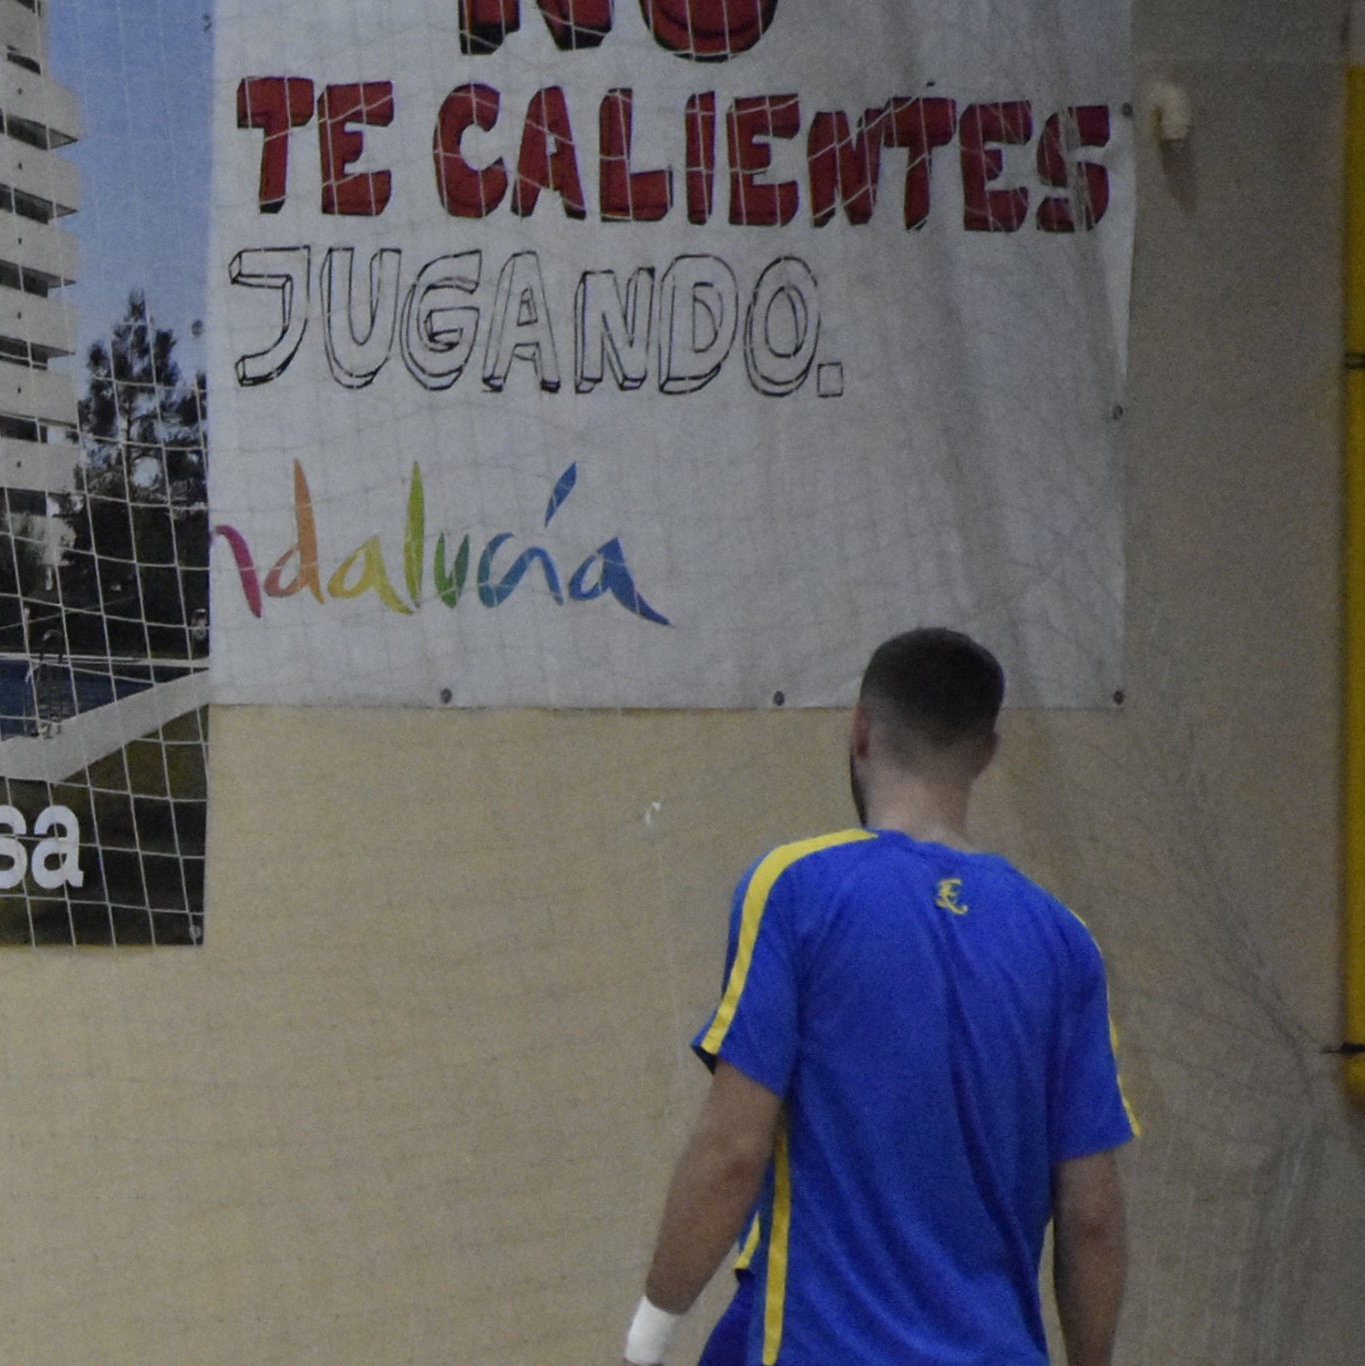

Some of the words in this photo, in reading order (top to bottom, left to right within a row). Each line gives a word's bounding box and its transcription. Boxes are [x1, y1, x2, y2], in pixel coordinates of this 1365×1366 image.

[237, 75, 394, 217] TE
[432, 83, 1110, 233] CALIENTES
[229, 243, 845, 398] JUGANDO.
